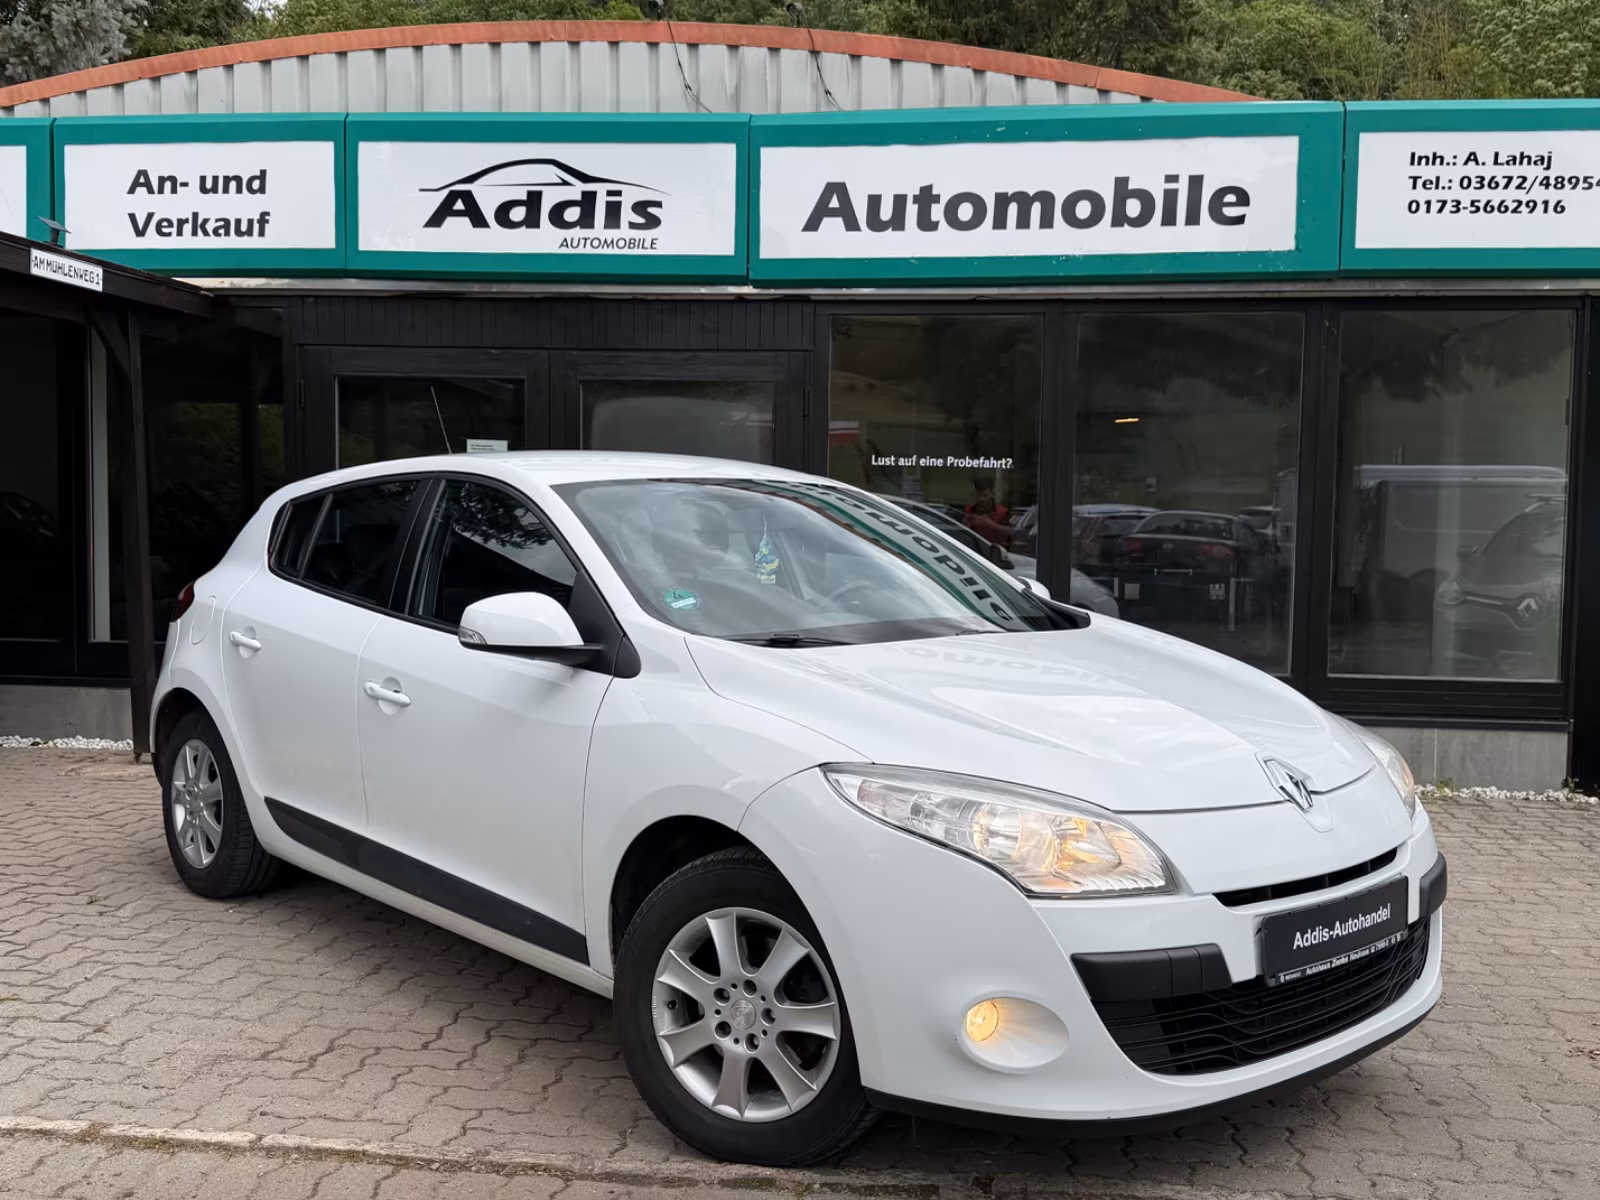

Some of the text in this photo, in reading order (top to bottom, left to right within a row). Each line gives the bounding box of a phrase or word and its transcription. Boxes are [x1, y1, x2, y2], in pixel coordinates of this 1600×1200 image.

[1409, 151, 1553, 171] Inh.: A. Lahaj
[127, 169, 267, 194] An- und
[1409, 175, 1453, 191] Tel.:
[421, 189, 664, 231] Addis
[801, 175, 1251, 233] Automobile
[1407, 199, 1566, 215] 0173-5662916
[128, 210, 270, 238] Verkauf
[559, 237, 658, 250] AUTOMOBILE
[871, 454, 1013, 469] Lust auf eine Probefahrt?
[1292, 902, 1391, 950] Addis-Autohandel
